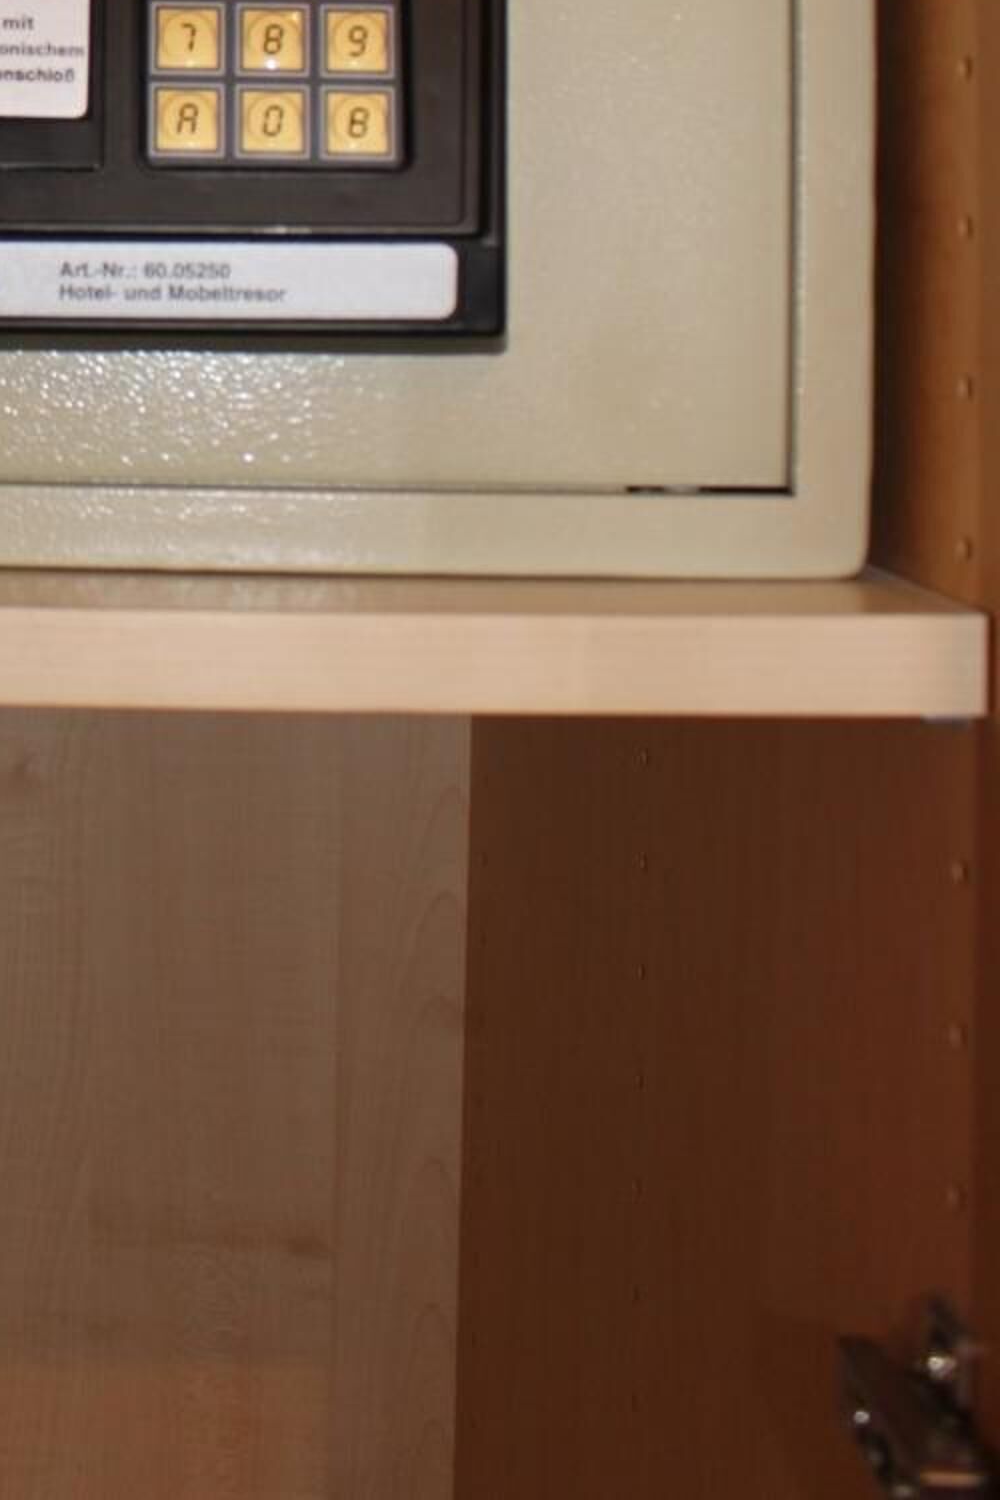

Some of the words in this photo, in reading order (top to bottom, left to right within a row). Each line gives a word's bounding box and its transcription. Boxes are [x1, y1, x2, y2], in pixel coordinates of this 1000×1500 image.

[2, 15, 34, 30] mit
[181, 22, 197, 53] 7
[263, 23, 284, 55] 8
[348, 25, 368, 57] 9
[176, 103, 199, 135] A
[58, 284, 120, 301] Hotel-
[124, 285, 162, 301] und
